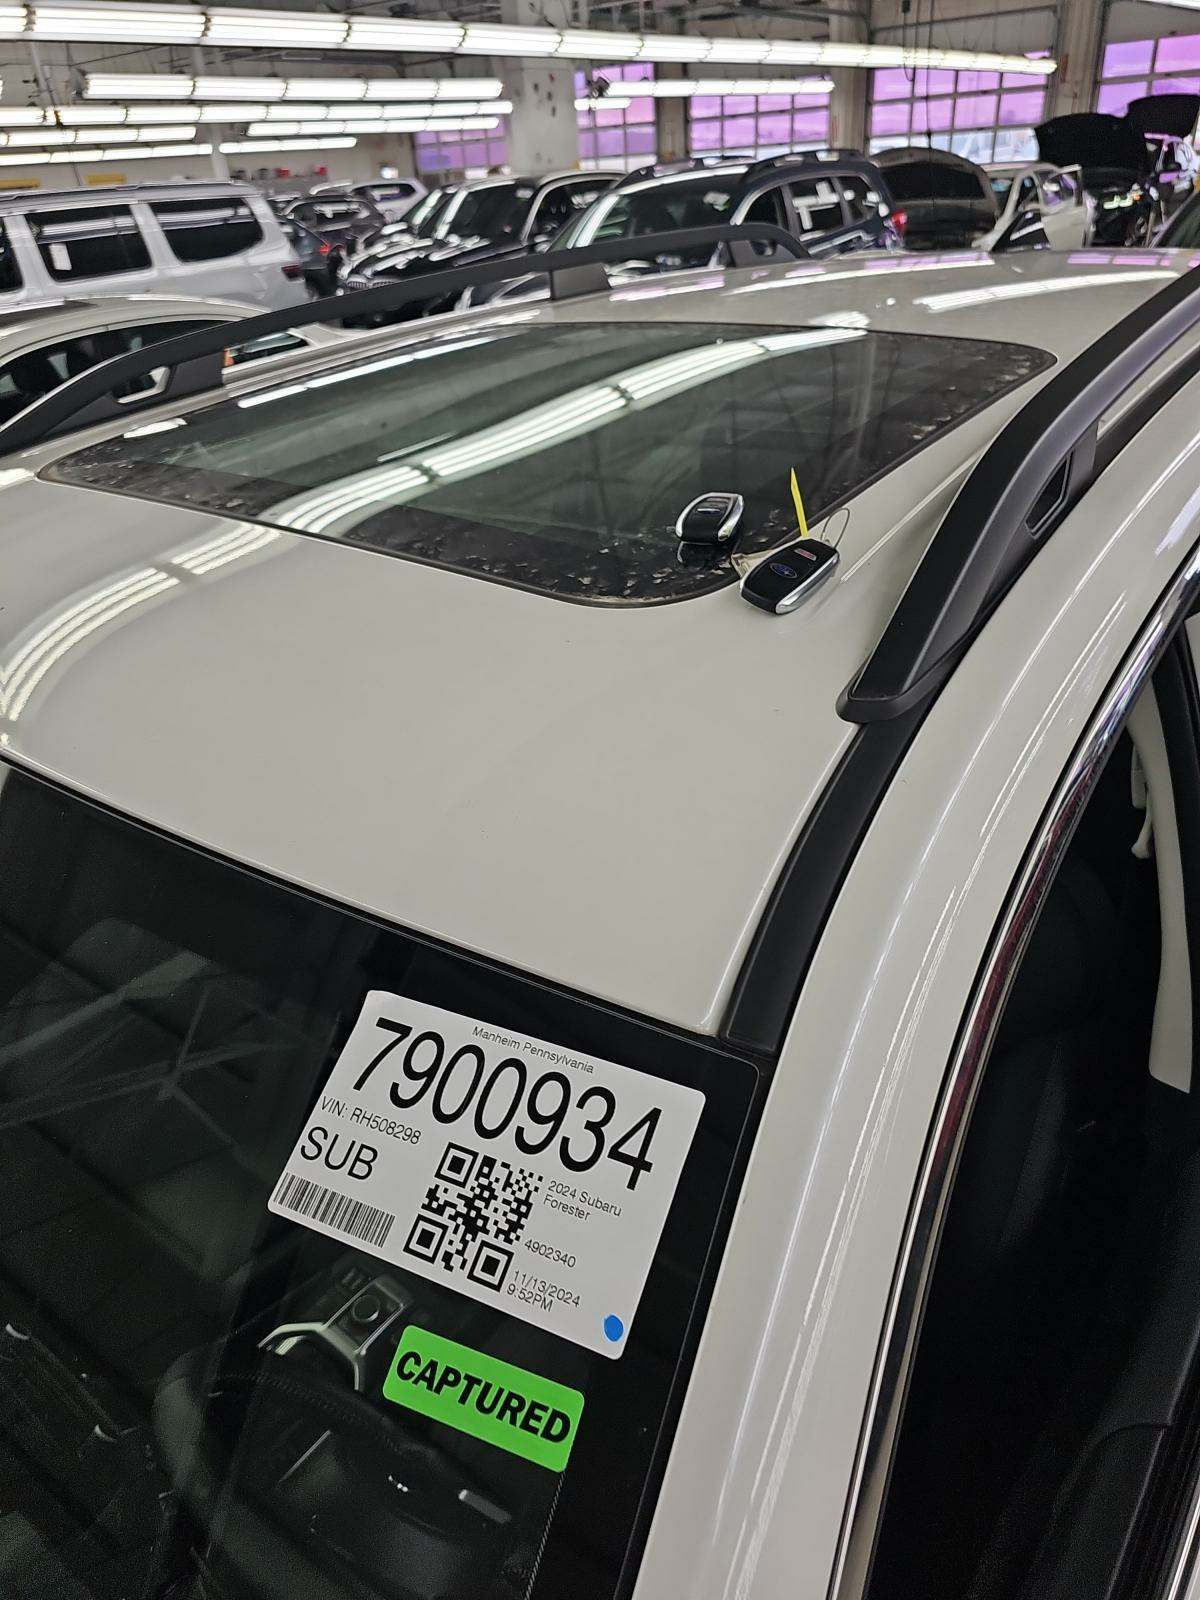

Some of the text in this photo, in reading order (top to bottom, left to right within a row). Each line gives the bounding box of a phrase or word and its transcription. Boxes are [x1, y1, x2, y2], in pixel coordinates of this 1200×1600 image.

[472, 1026, 594, 1074] Manheim Pennsylvania
[321, 1095, 422, 1145] VIN: RH508298
[352, 1017, 662, 1191] 7900934
[300, 1126, 378, 1180] SUB
[543, 1194, 591, 1220] Forester
[548, 1180, 622, 1217] 2024 Subaru
[524, 1239, 576, 1268] 4902340
[506, 1283, 553, 1312] 9:52PM
[514, 1270, 581, 1307] 11/13/2024
[396, 1350, 570, 1443] CAPTURED
